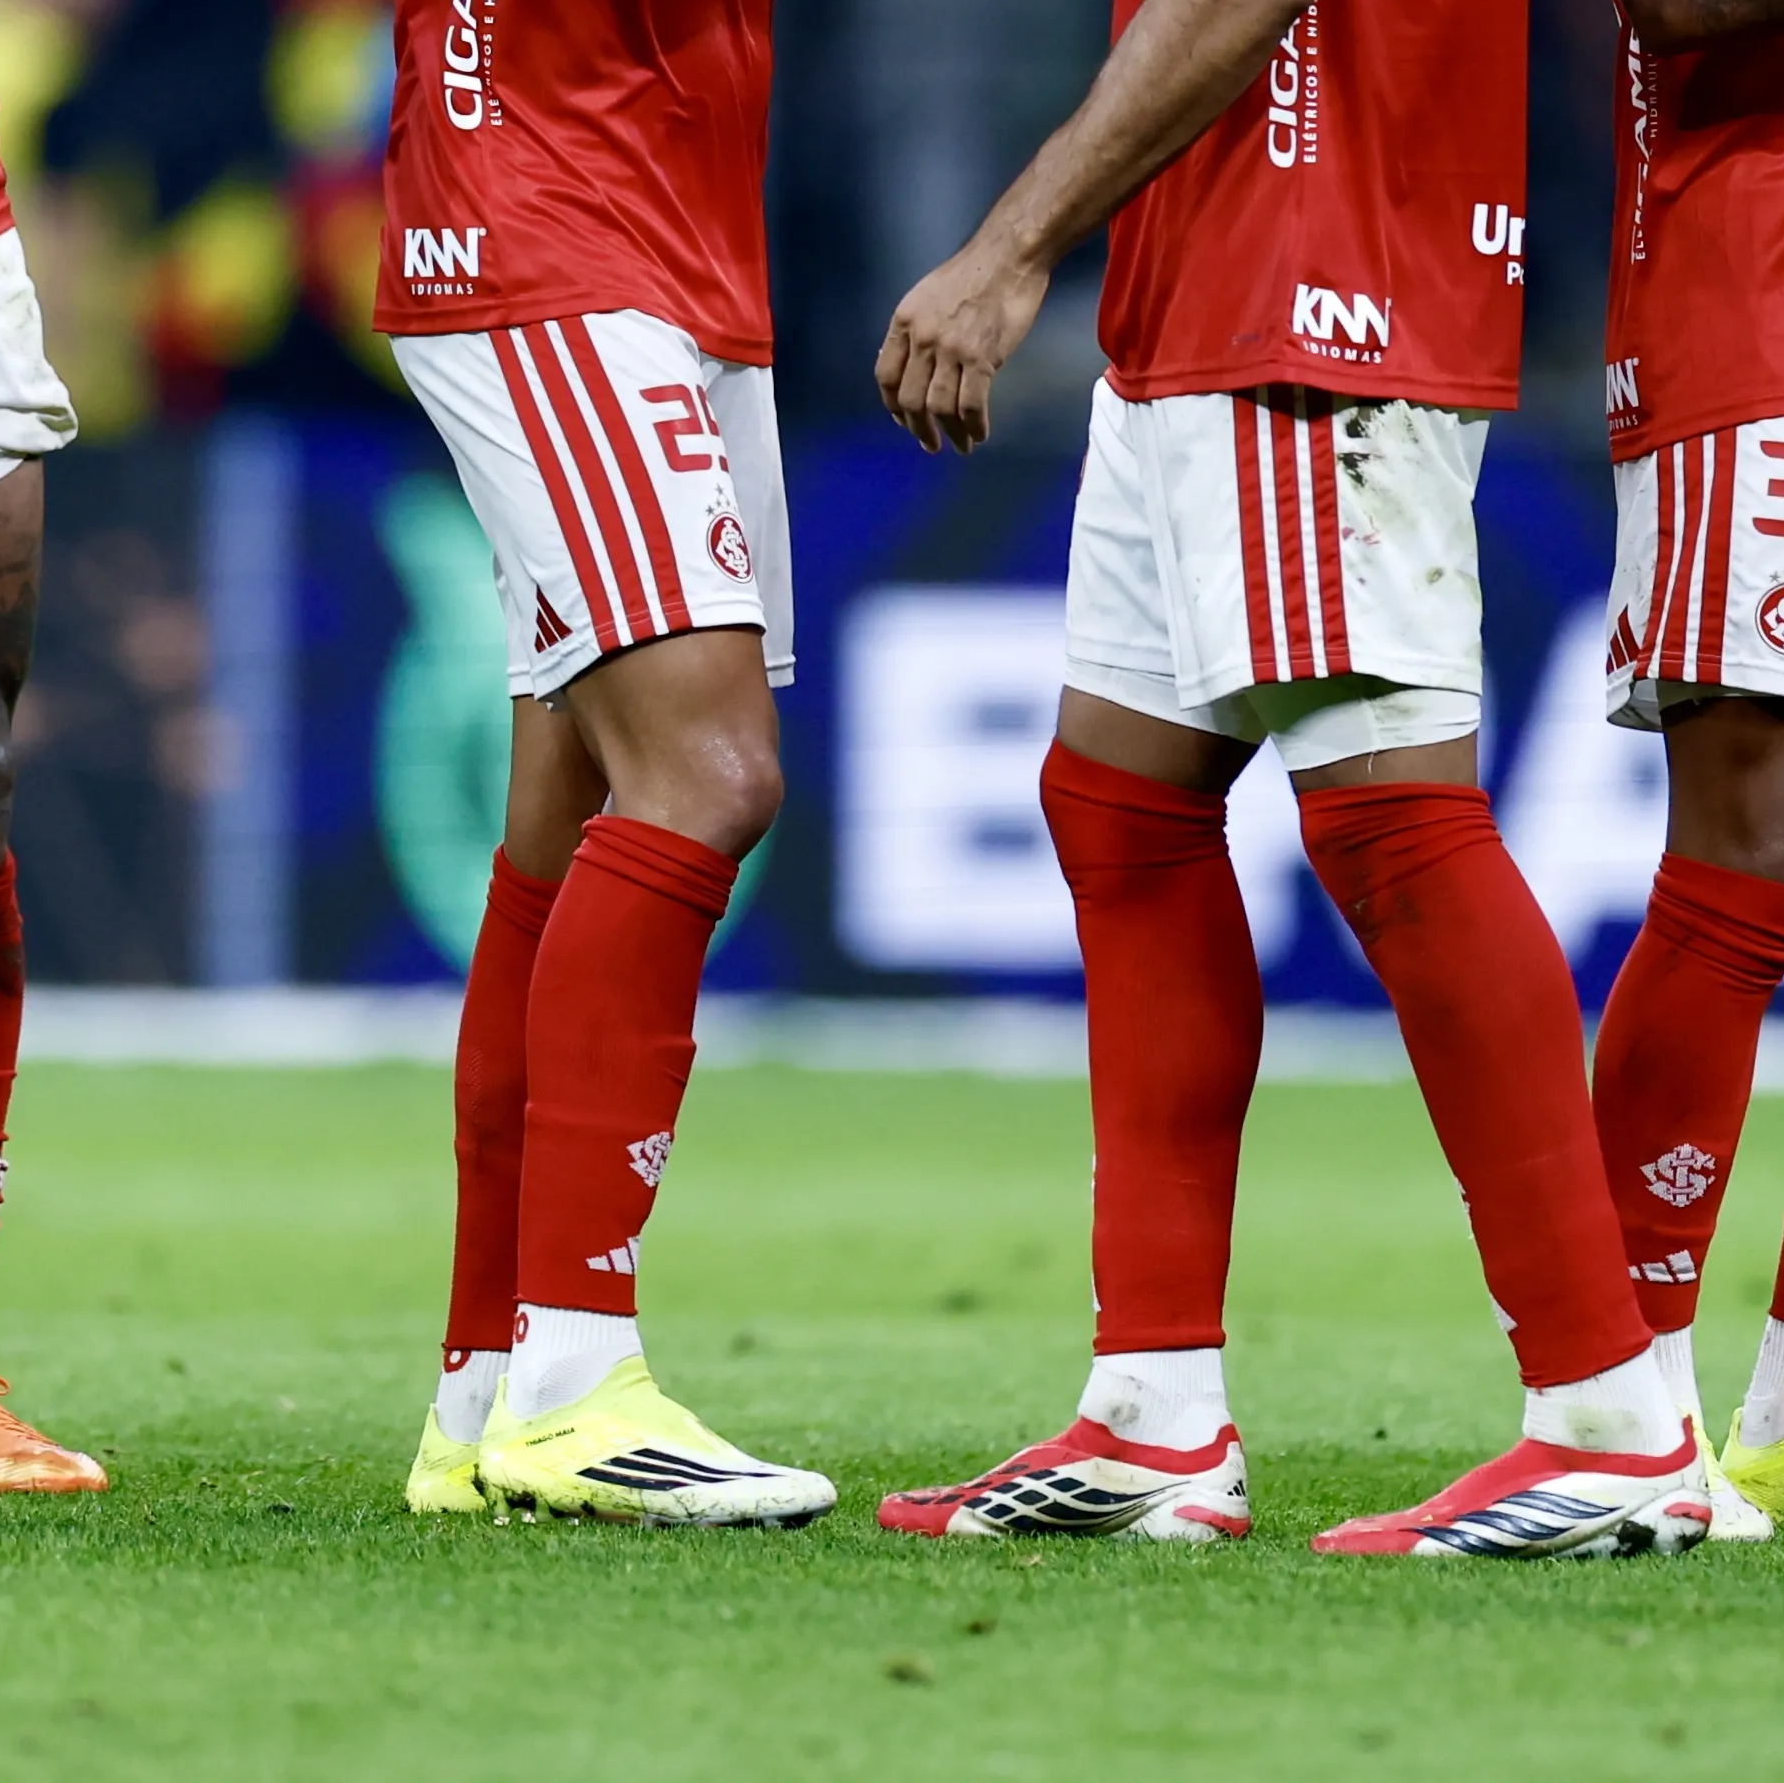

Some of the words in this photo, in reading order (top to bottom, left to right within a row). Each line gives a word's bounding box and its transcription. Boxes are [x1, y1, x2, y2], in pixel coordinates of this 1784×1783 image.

[1306, 46, 1317, 55] E
[1303, 64, 1317, 163] ELÉTRICOS
[404, 227, 480, 278] KNN
[411, 282, 474, 296] IDIOMAS
[1293, 283, 1390, 348] KNN
[1303, 340, 1382, 364] IDIOMAS
[555, 1427, 576, 1438] MAIA
